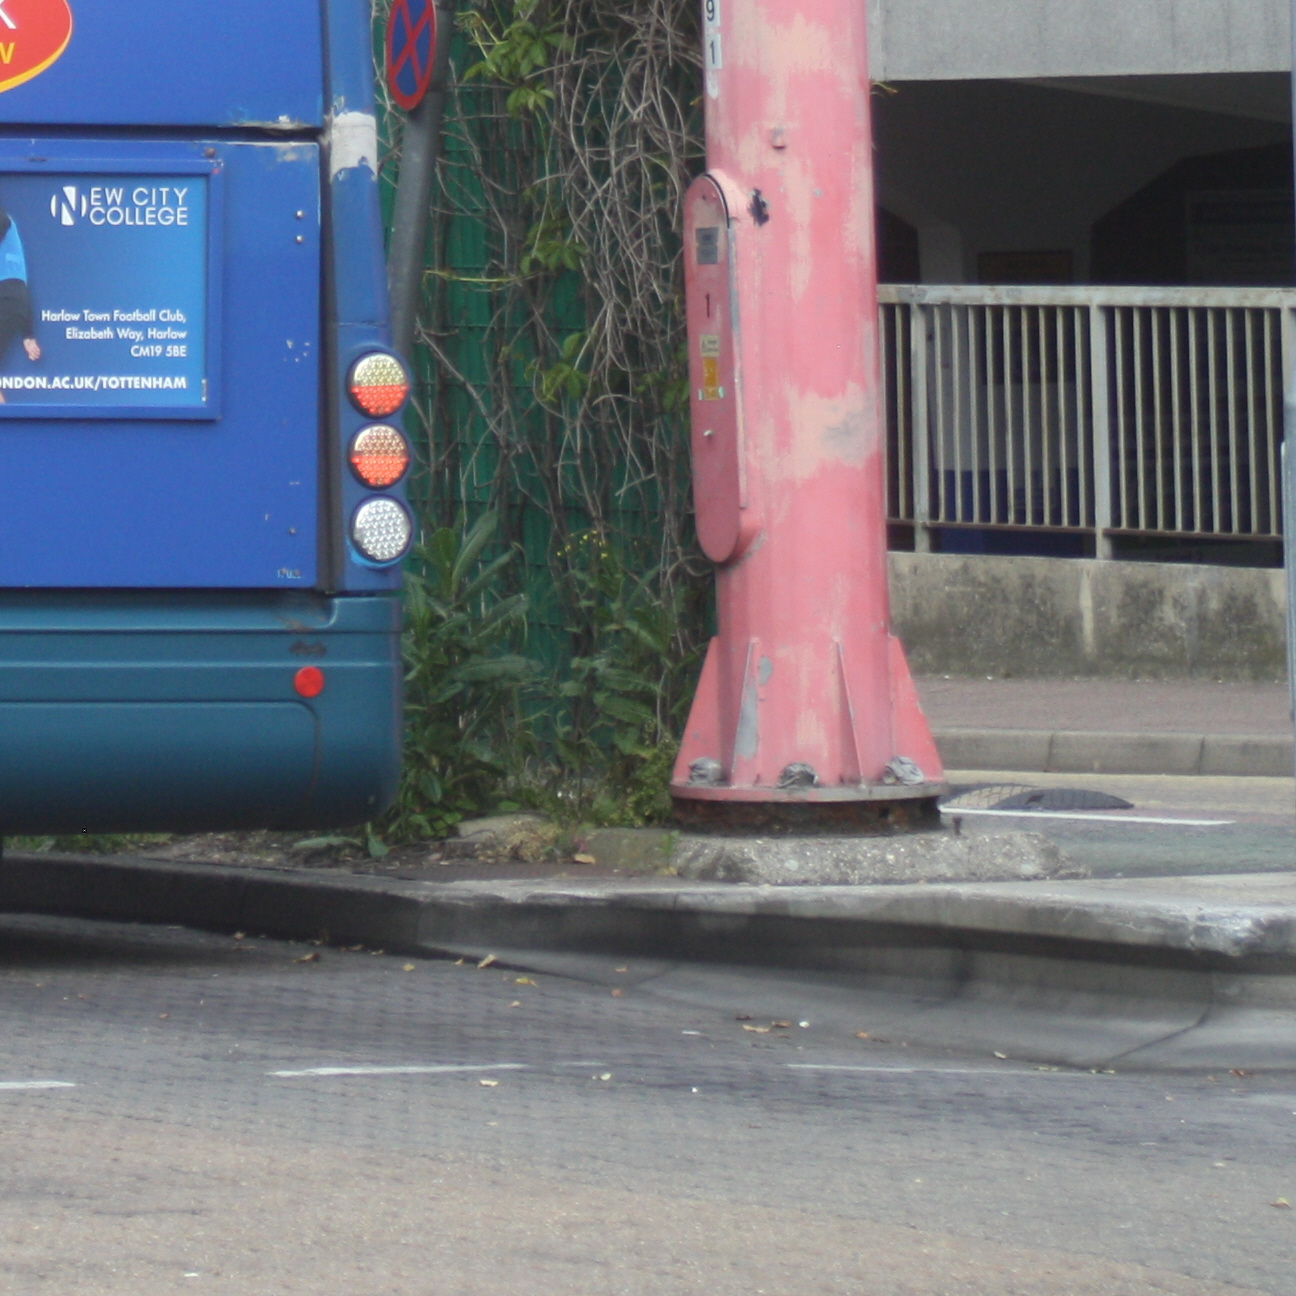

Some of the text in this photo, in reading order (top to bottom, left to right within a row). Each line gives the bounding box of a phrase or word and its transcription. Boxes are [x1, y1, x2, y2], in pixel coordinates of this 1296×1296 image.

[132, 187, 188, 206] CITY
[89, 206, 188, 225] COLLEGE
[41, 310, 187, 323] Harlow Town Football Club,
[65, 327, 187, 342] Elizabeth Way, Harlow
[130, 345, 187, 357] CM19 5BE
